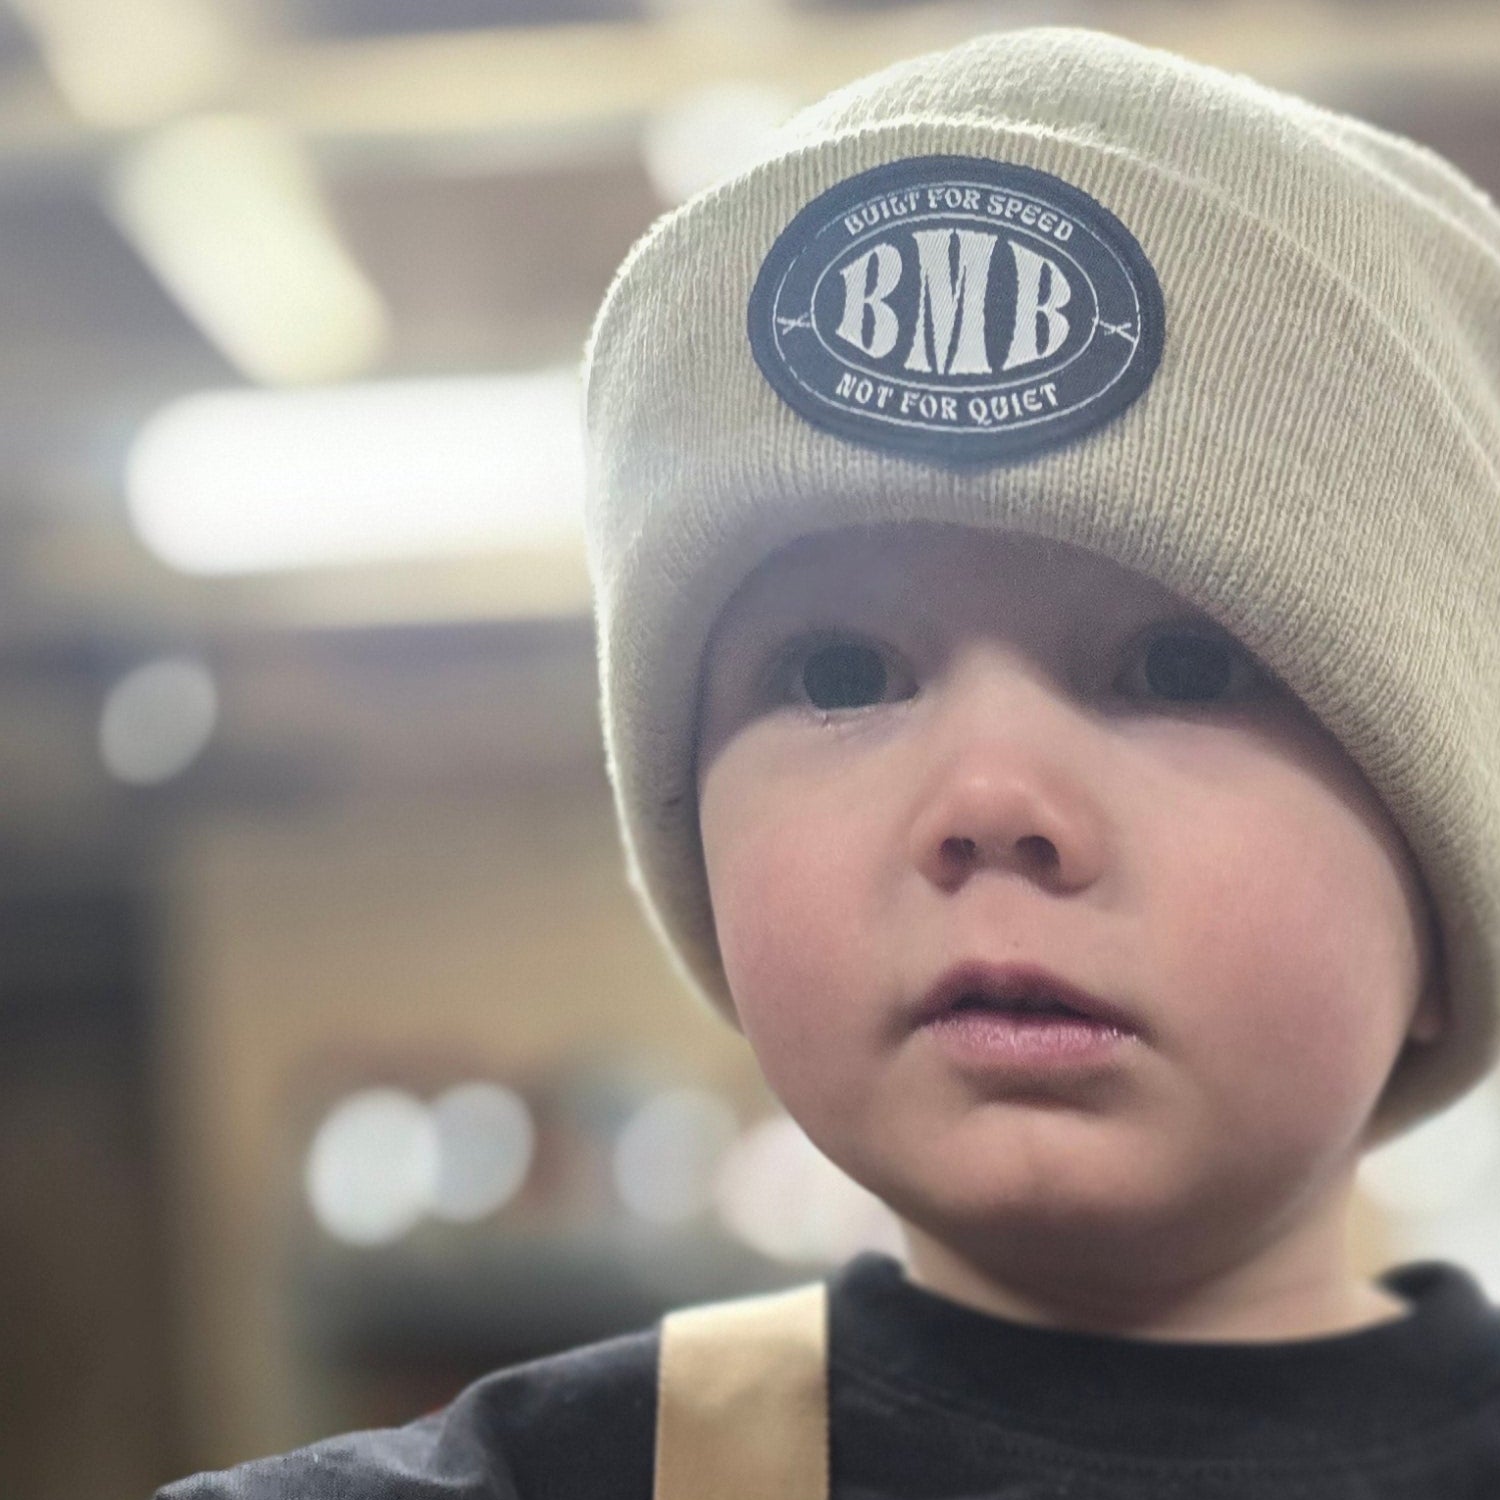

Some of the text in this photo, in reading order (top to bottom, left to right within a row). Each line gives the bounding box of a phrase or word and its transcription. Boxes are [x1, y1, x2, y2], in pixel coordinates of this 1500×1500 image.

[844, 187, 1074, 242] BUILT FOR SPEED
[836, 228, 1072, 375] BMB
[836, 372, 1058, 426] NOT FOR QUIET
